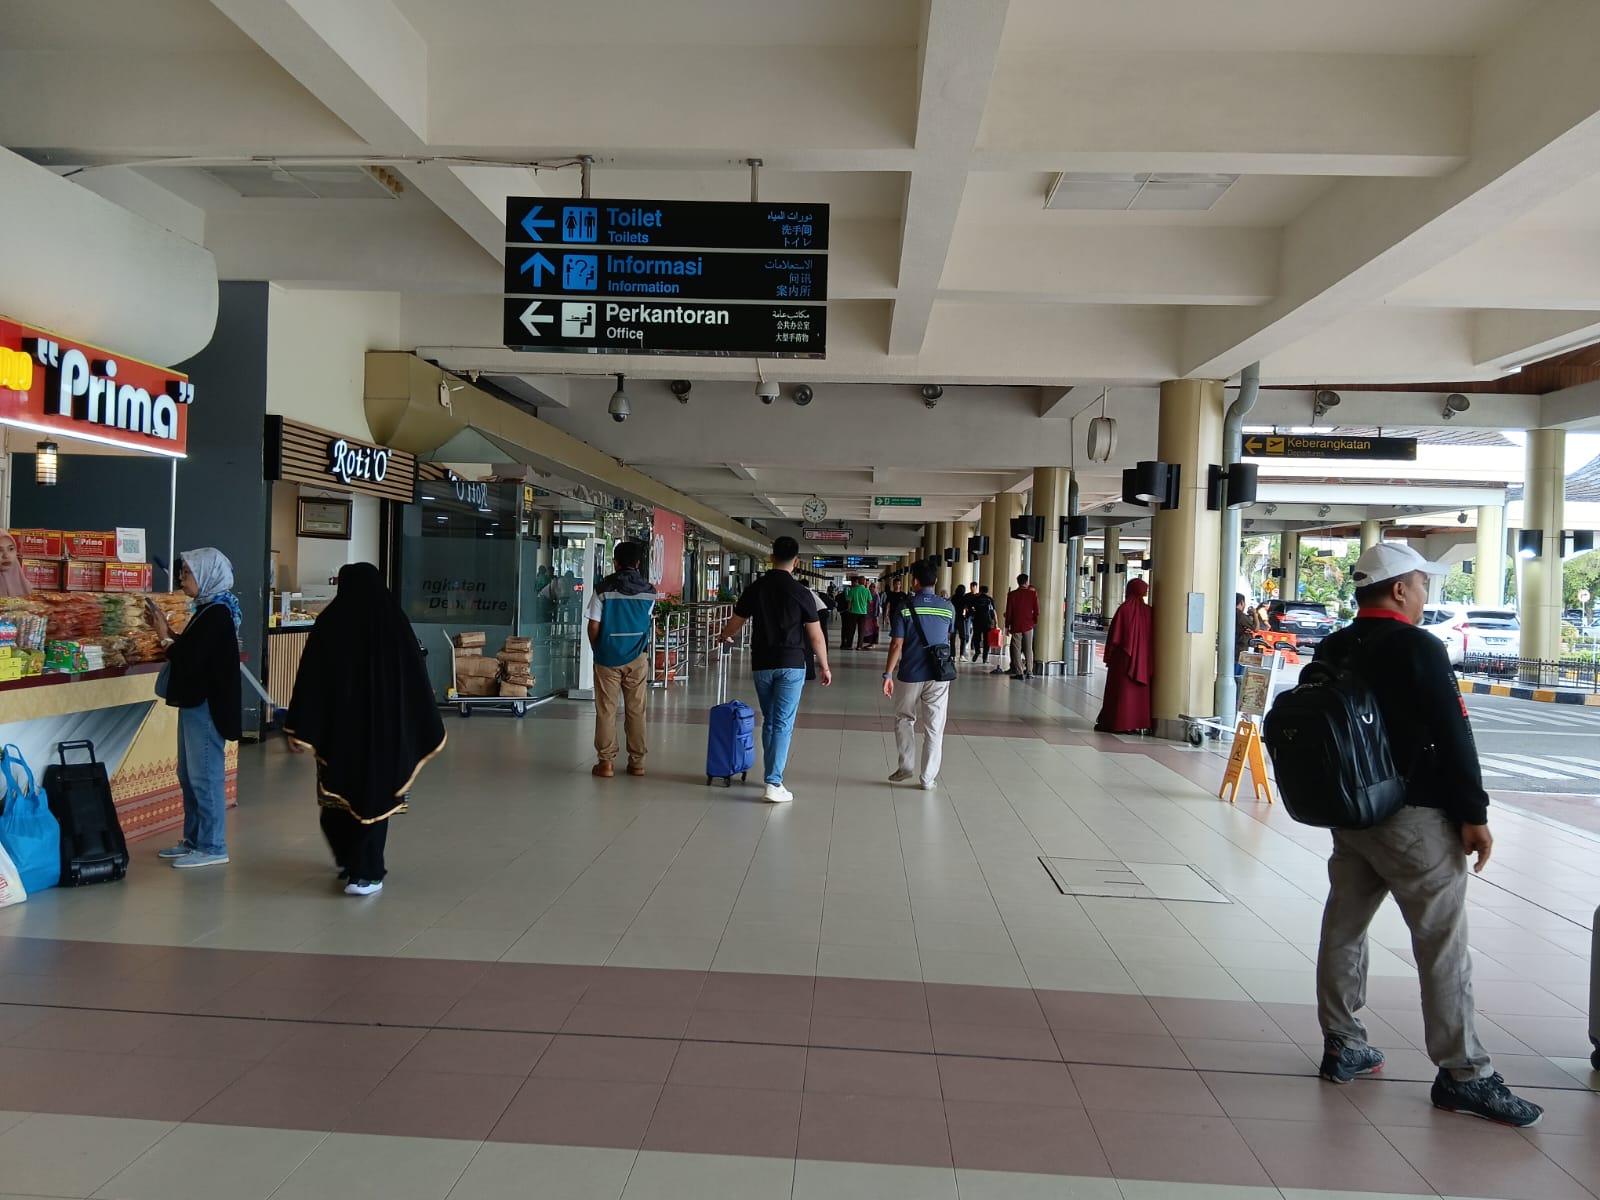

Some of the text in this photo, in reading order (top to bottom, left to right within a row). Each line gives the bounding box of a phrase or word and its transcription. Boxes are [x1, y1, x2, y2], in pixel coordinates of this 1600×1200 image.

[606, 207, 663, 227] Toilet
[608, 230, 649, 243] Toilets
[781, 224, 813, 237] 洗手间
[784, 236, 812, 248] トイレ
[607, 254, 703, 276] Informasi
[608, 280, 680, 293] Information
[776, 284, 811, 297] 案内所
[606, 303, 729, 325] Perkantoran
[606, 327, 644, 340] Office
[1287, 438, 1371, 451] Keberangkatan
[80, 538, 103, 546] Prima
[429, 597, 508, 611] Deprture
